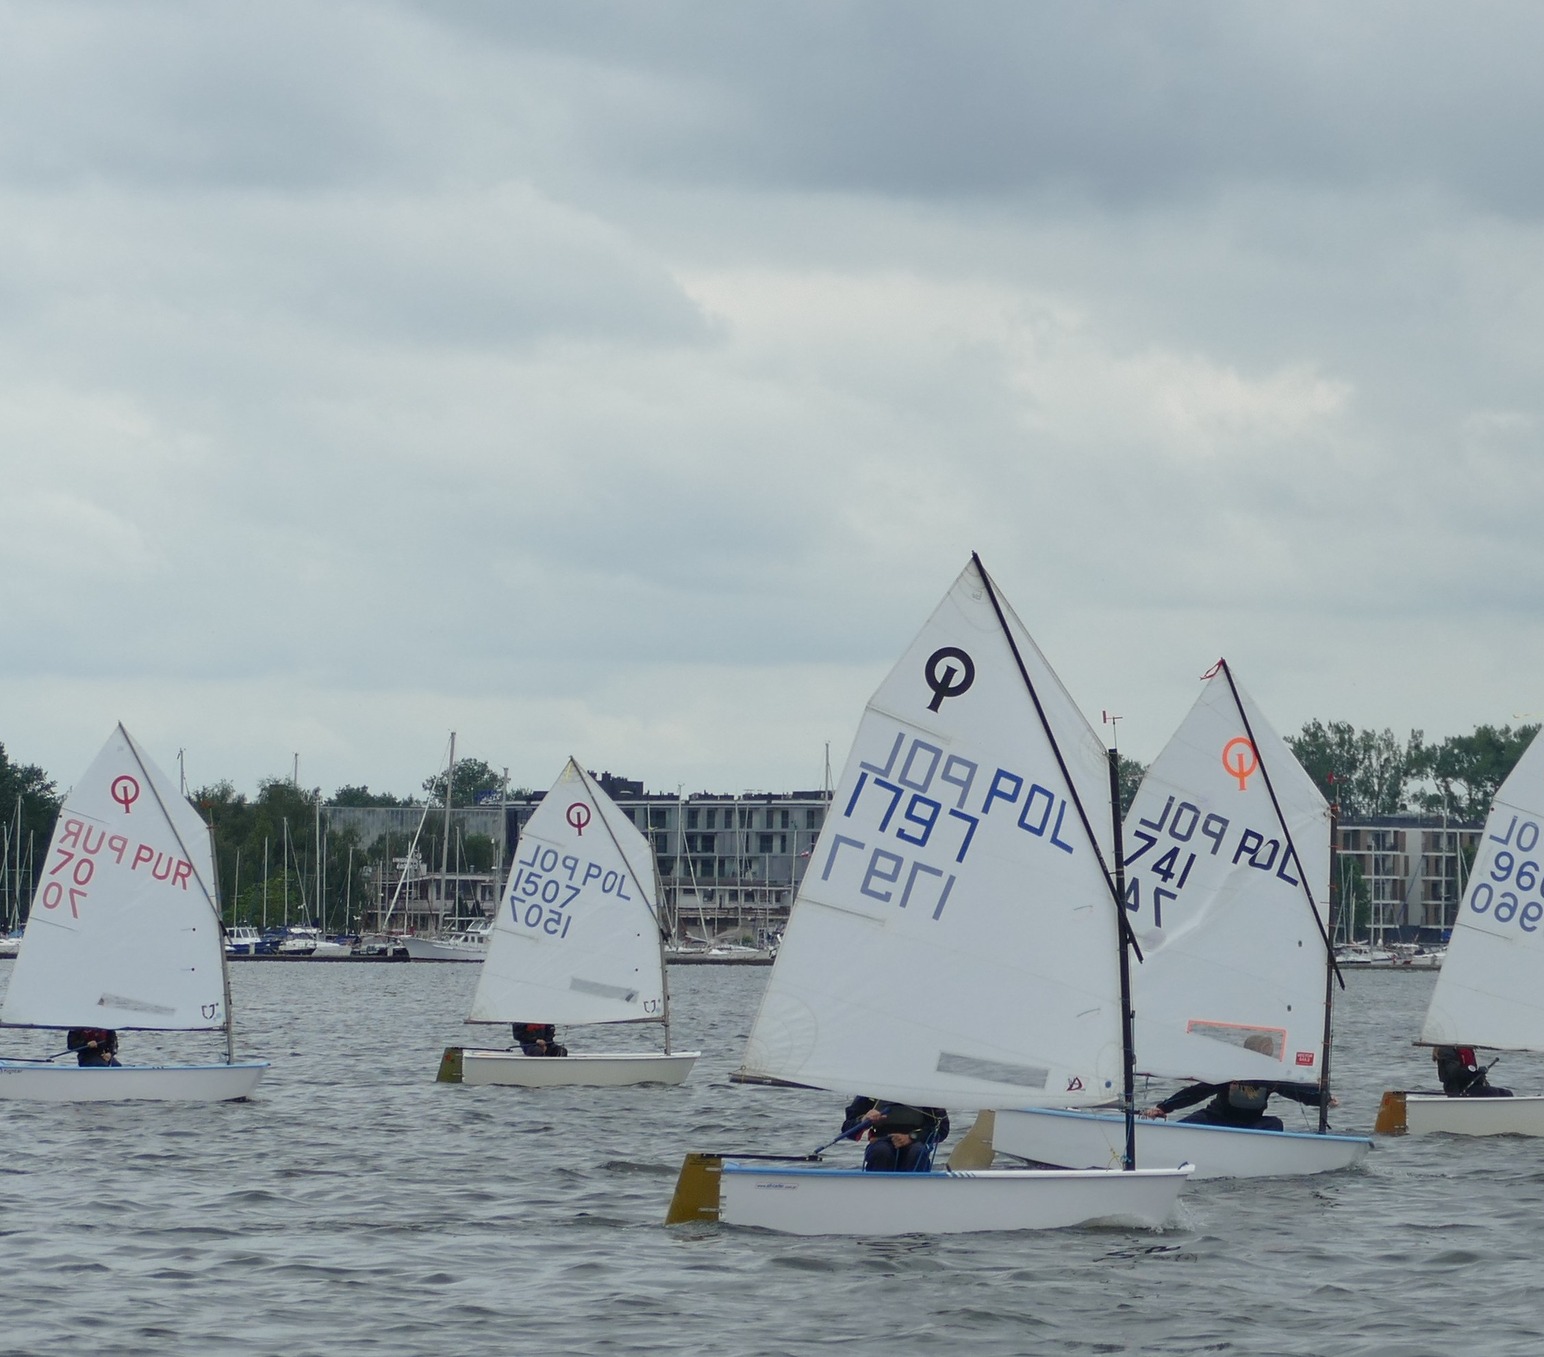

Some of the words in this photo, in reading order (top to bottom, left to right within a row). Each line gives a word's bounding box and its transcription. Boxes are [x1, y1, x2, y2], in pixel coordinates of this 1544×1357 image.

[844, 771, 979, 863] 1797
[981, 767, 1073, 855] POL
[50, 848, 94, 886] 70
[131, 844, 192, 890] PUR
[582, 862, 631, 901] POL
[1123, 830, 1196, 889] 741
[1232, 828, 1299, 887] POL
[513, 868, 581, 909] 1507
